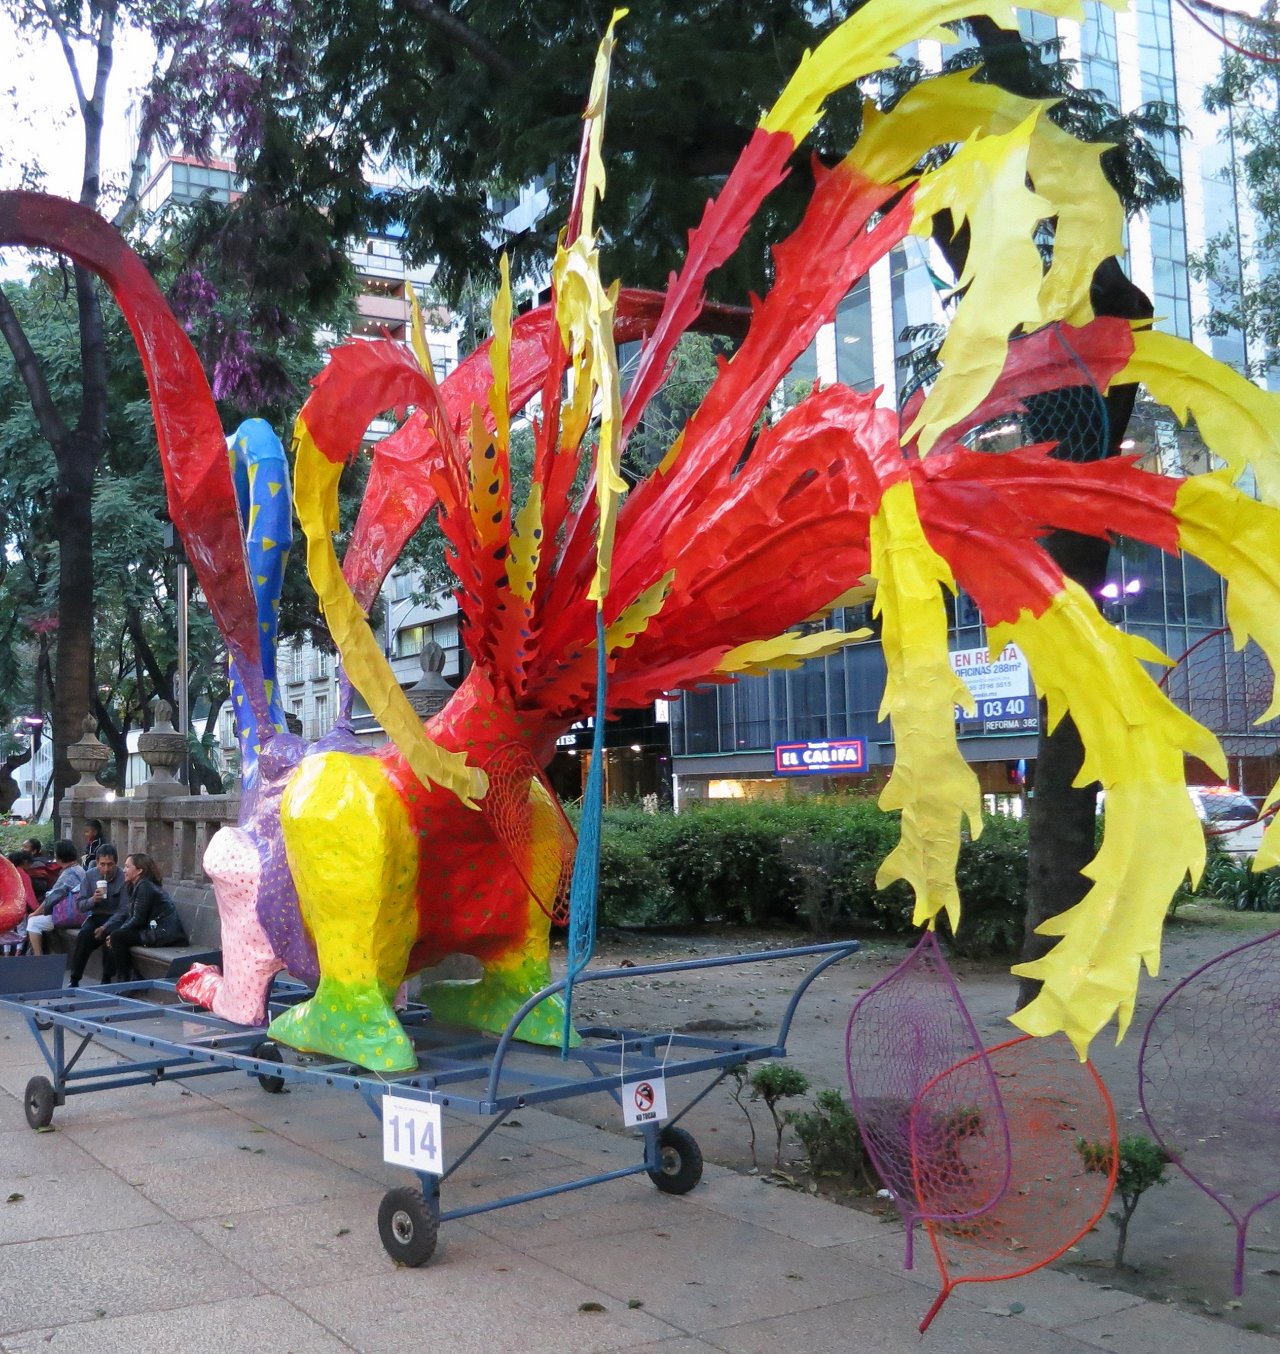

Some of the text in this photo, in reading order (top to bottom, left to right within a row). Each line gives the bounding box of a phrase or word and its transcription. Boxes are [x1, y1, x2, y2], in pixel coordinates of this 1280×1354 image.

[955, 647, 1017, 667] EN RETA
[983, 701, 1003, 718] 03
[1005, 699, 1025, 715] 40
[986, 718, 1038, 731] REFORMA 382
[782, 748, 857, 766] EL CALIFA
[389, 1115, 437, 1160] 114
